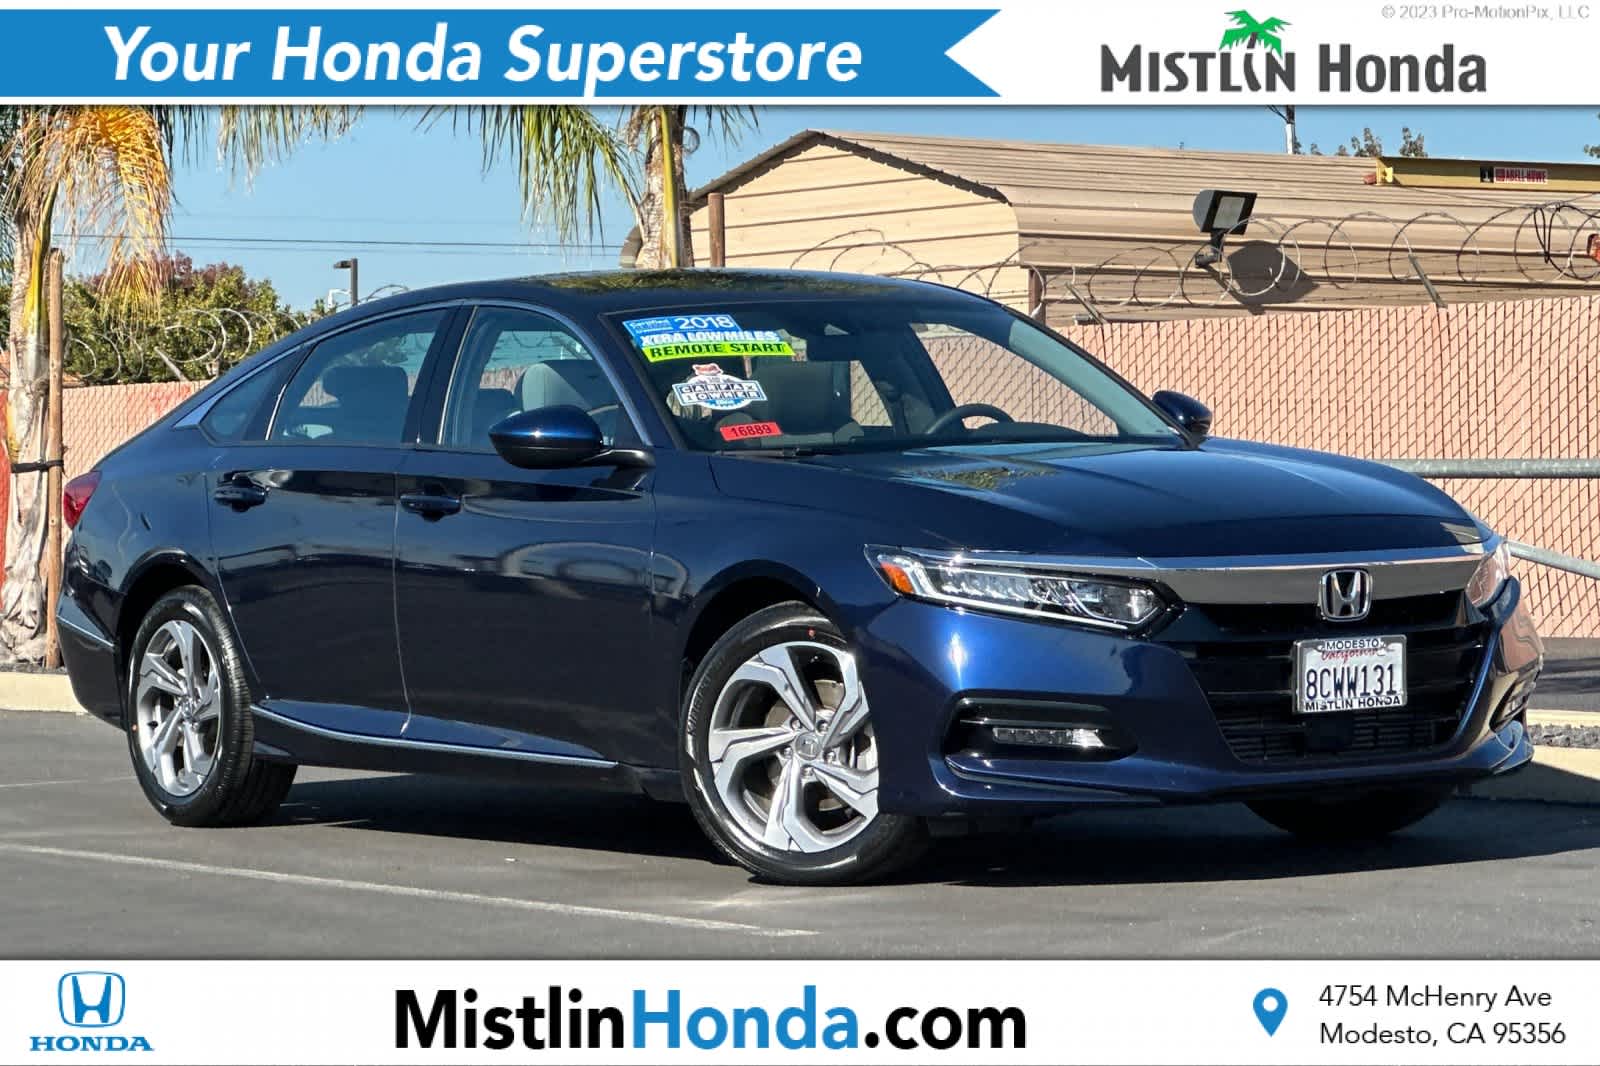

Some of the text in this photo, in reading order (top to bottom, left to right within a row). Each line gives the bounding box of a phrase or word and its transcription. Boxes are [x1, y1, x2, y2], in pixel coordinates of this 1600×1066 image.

[674, 316, 733, 330] 2018
[686, 331, 723, 343] LOW
[721, 330, 780, 343] MILES
[650, 342, 784, 358] REMOTE START
[679, 383, 757, 393] CARFAX
[696, 391, 760, 401] OWNER
[1325, 638, 1380, 650] MODESTO
[1306, 664, 1397, 701] 8CWW131
[1305, 695, 1401, 711] MISTLIN HONDA
